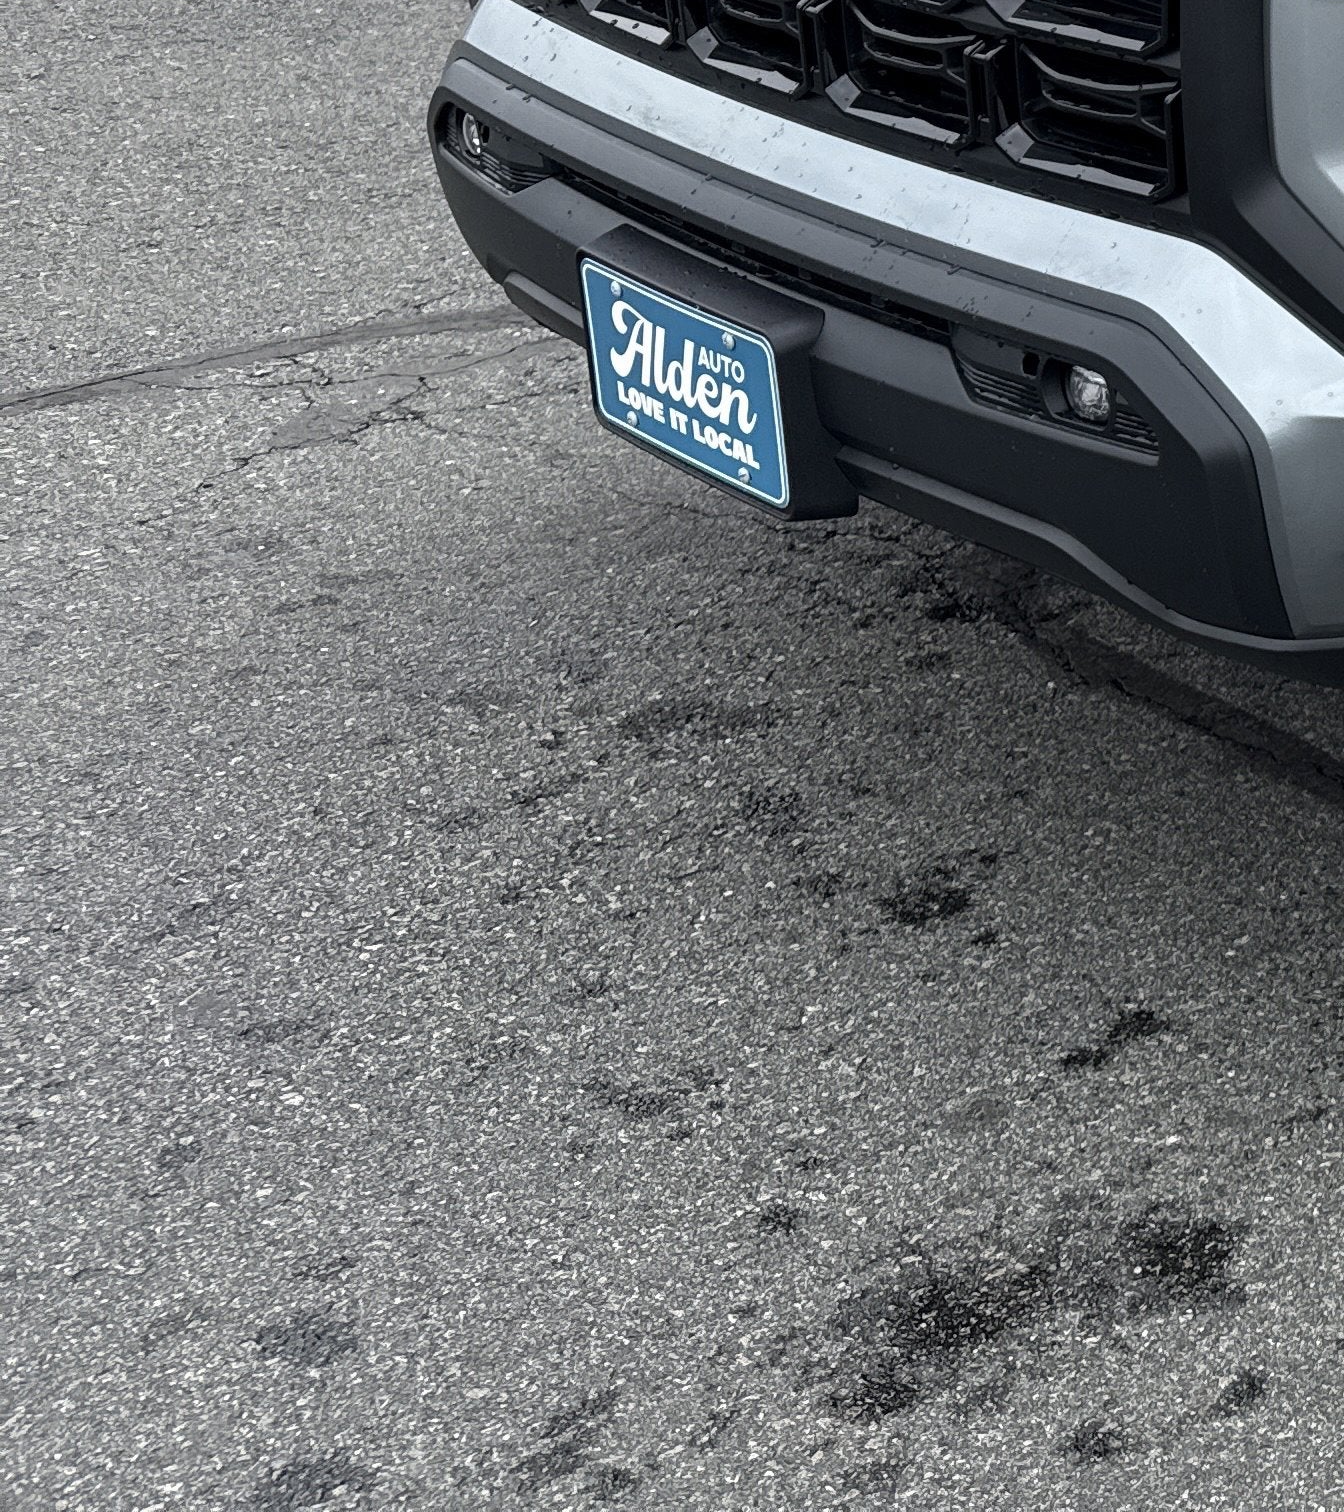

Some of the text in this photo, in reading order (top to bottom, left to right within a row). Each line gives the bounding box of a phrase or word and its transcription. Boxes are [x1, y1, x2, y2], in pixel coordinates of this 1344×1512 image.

[610, 300, 757, 434] Alden
[698, 347, 745, 383] AUTO
[616, 381, 760, 470] LOVE IT LOCAL
